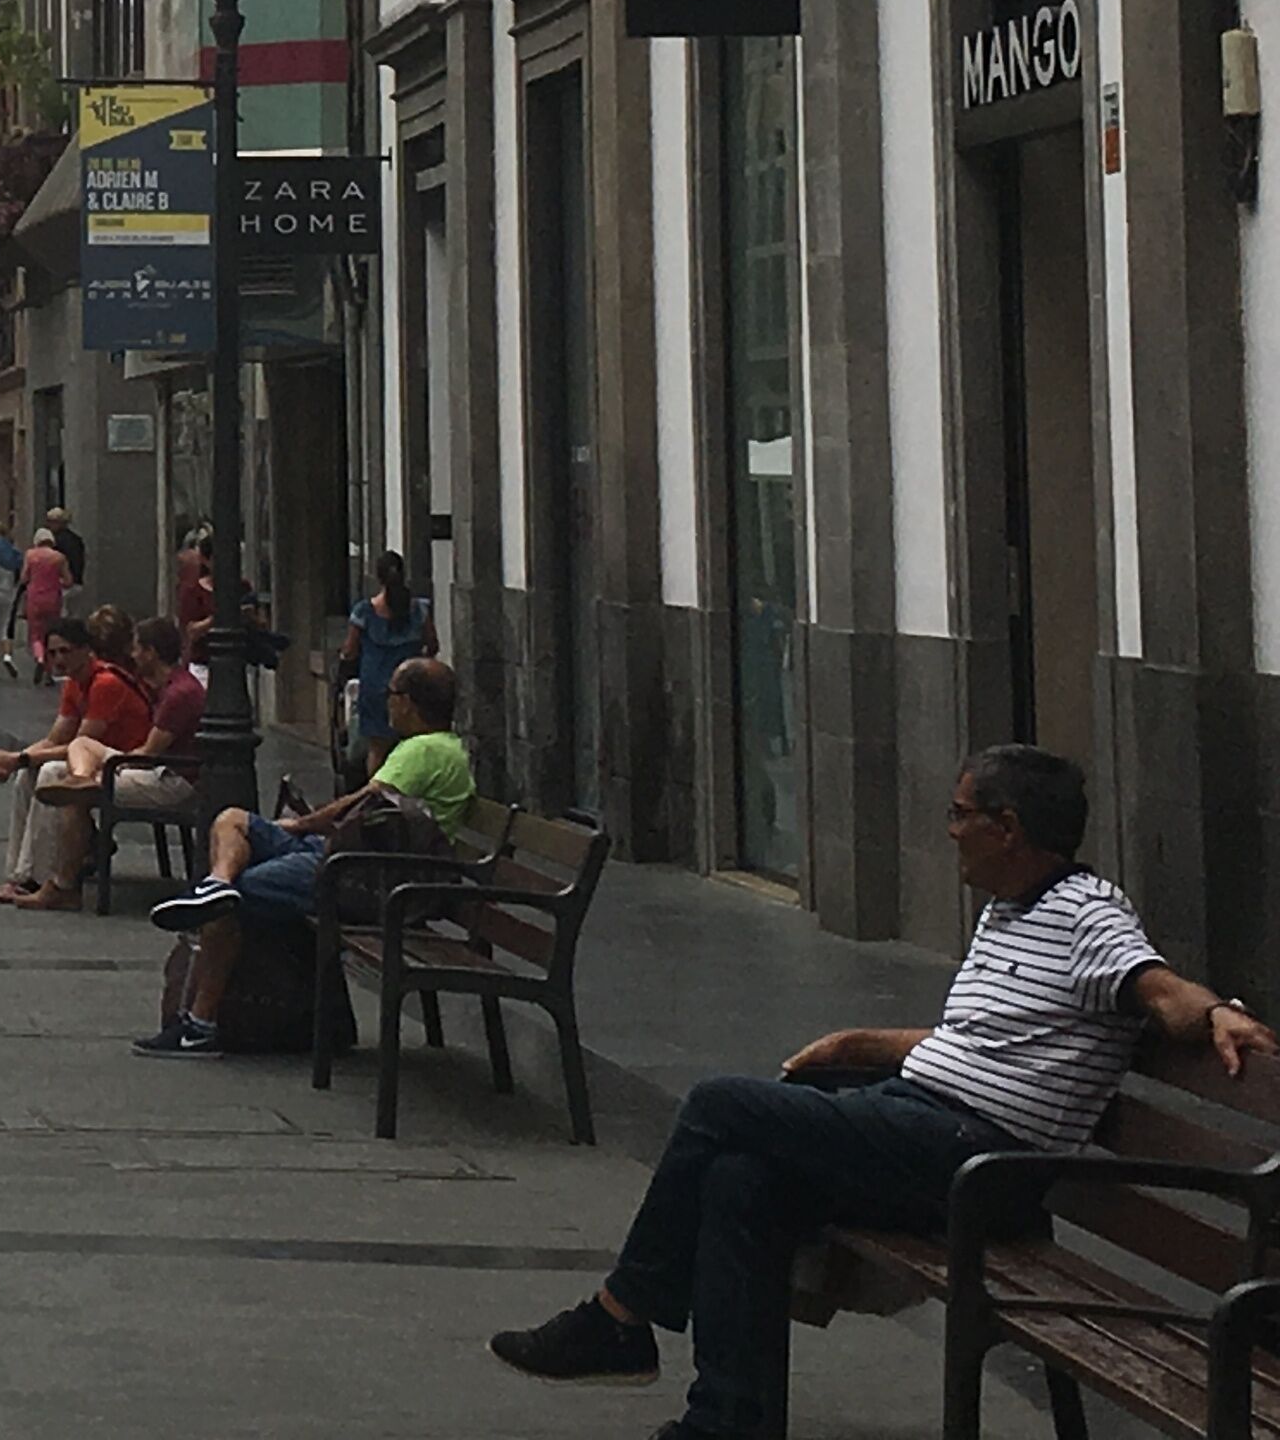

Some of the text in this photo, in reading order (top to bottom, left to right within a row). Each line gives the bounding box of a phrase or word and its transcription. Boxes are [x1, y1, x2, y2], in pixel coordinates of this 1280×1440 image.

[86, 170, 159, 189] ADRIEN M
[244, 180, 365, 201] ZARA
[87, 192, 169, 210] & CLAIRE B
[240, 213, 368, 234] HOME
